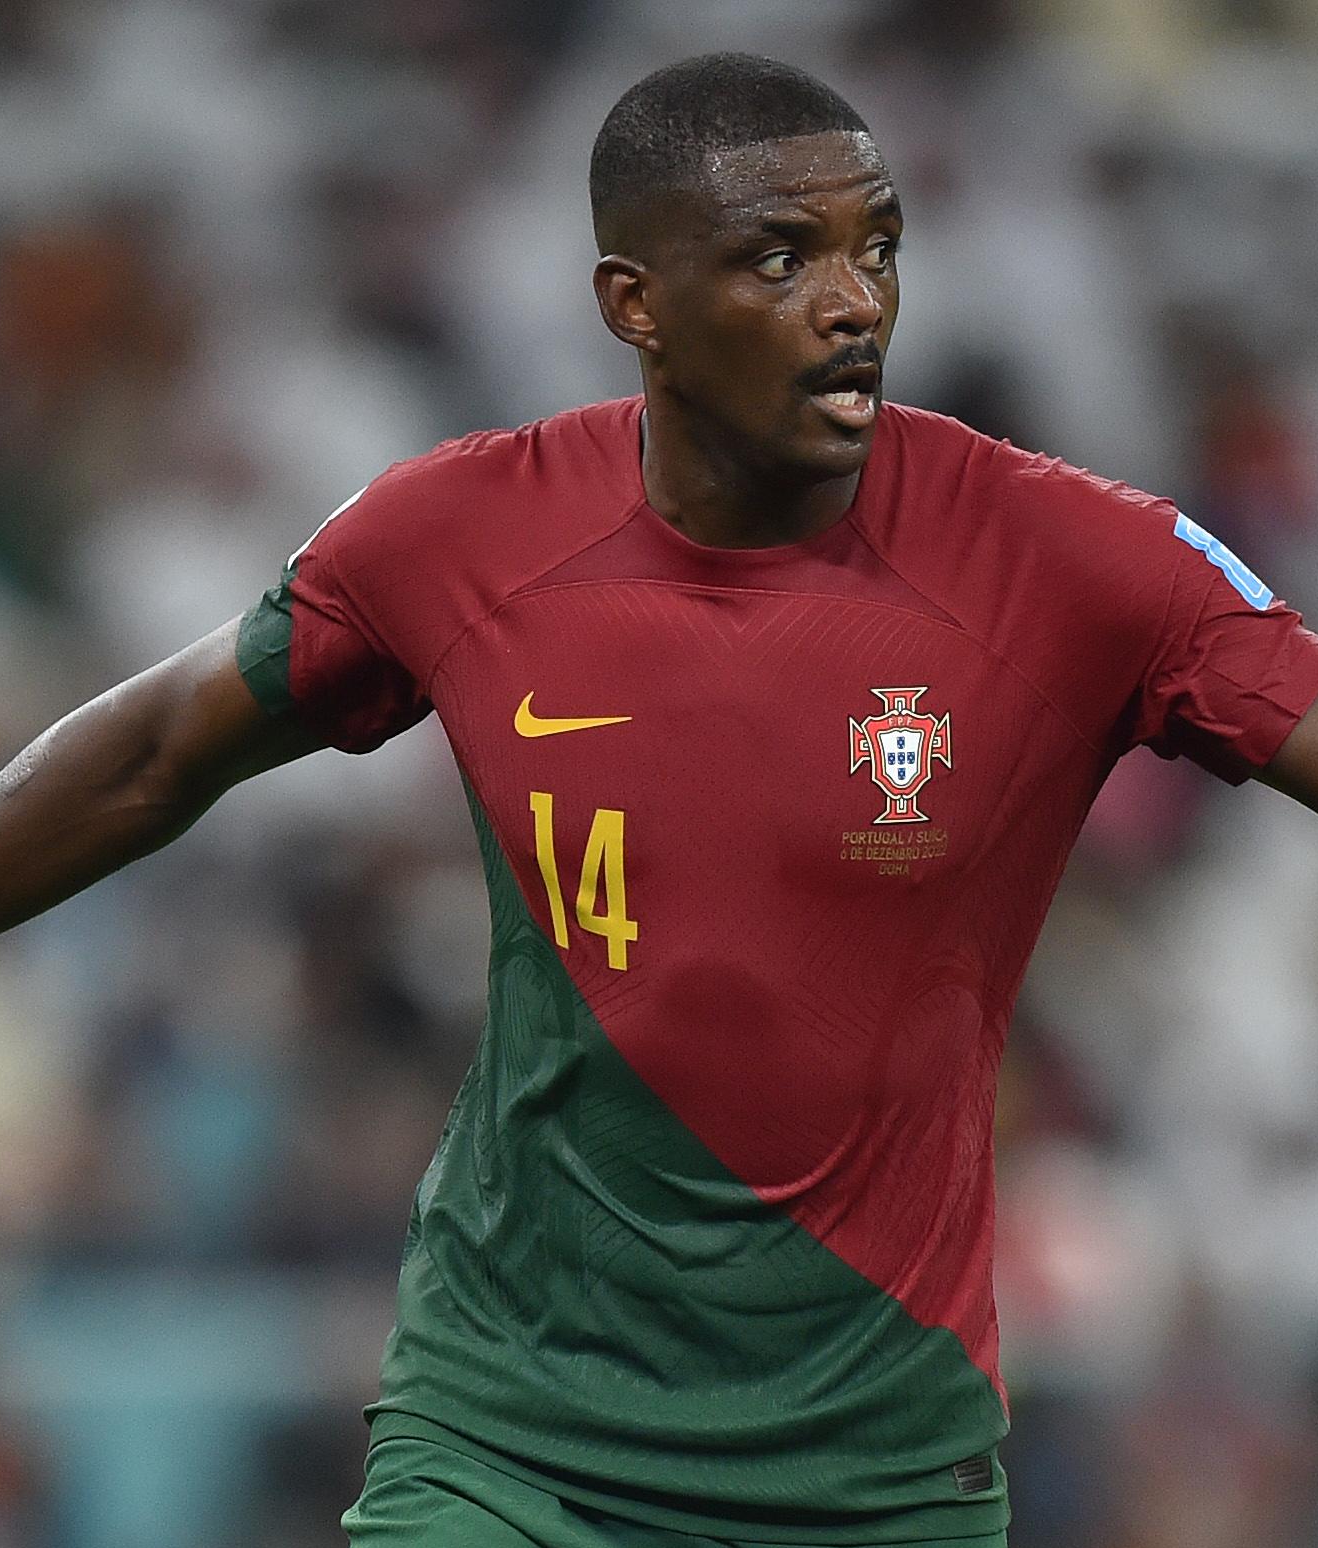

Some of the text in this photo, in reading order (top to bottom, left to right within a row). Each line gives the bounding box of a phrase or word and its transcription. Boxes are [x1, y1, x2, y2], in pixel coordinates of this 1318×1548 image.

[842, 831, 904, 845] PORTUGAL
[840, 847, 847, 860] 6
[850, 847, 863, 860] DE
[866, 847, 920, 860] DEZEMBRO
[530, 791, 638, 970] 14
